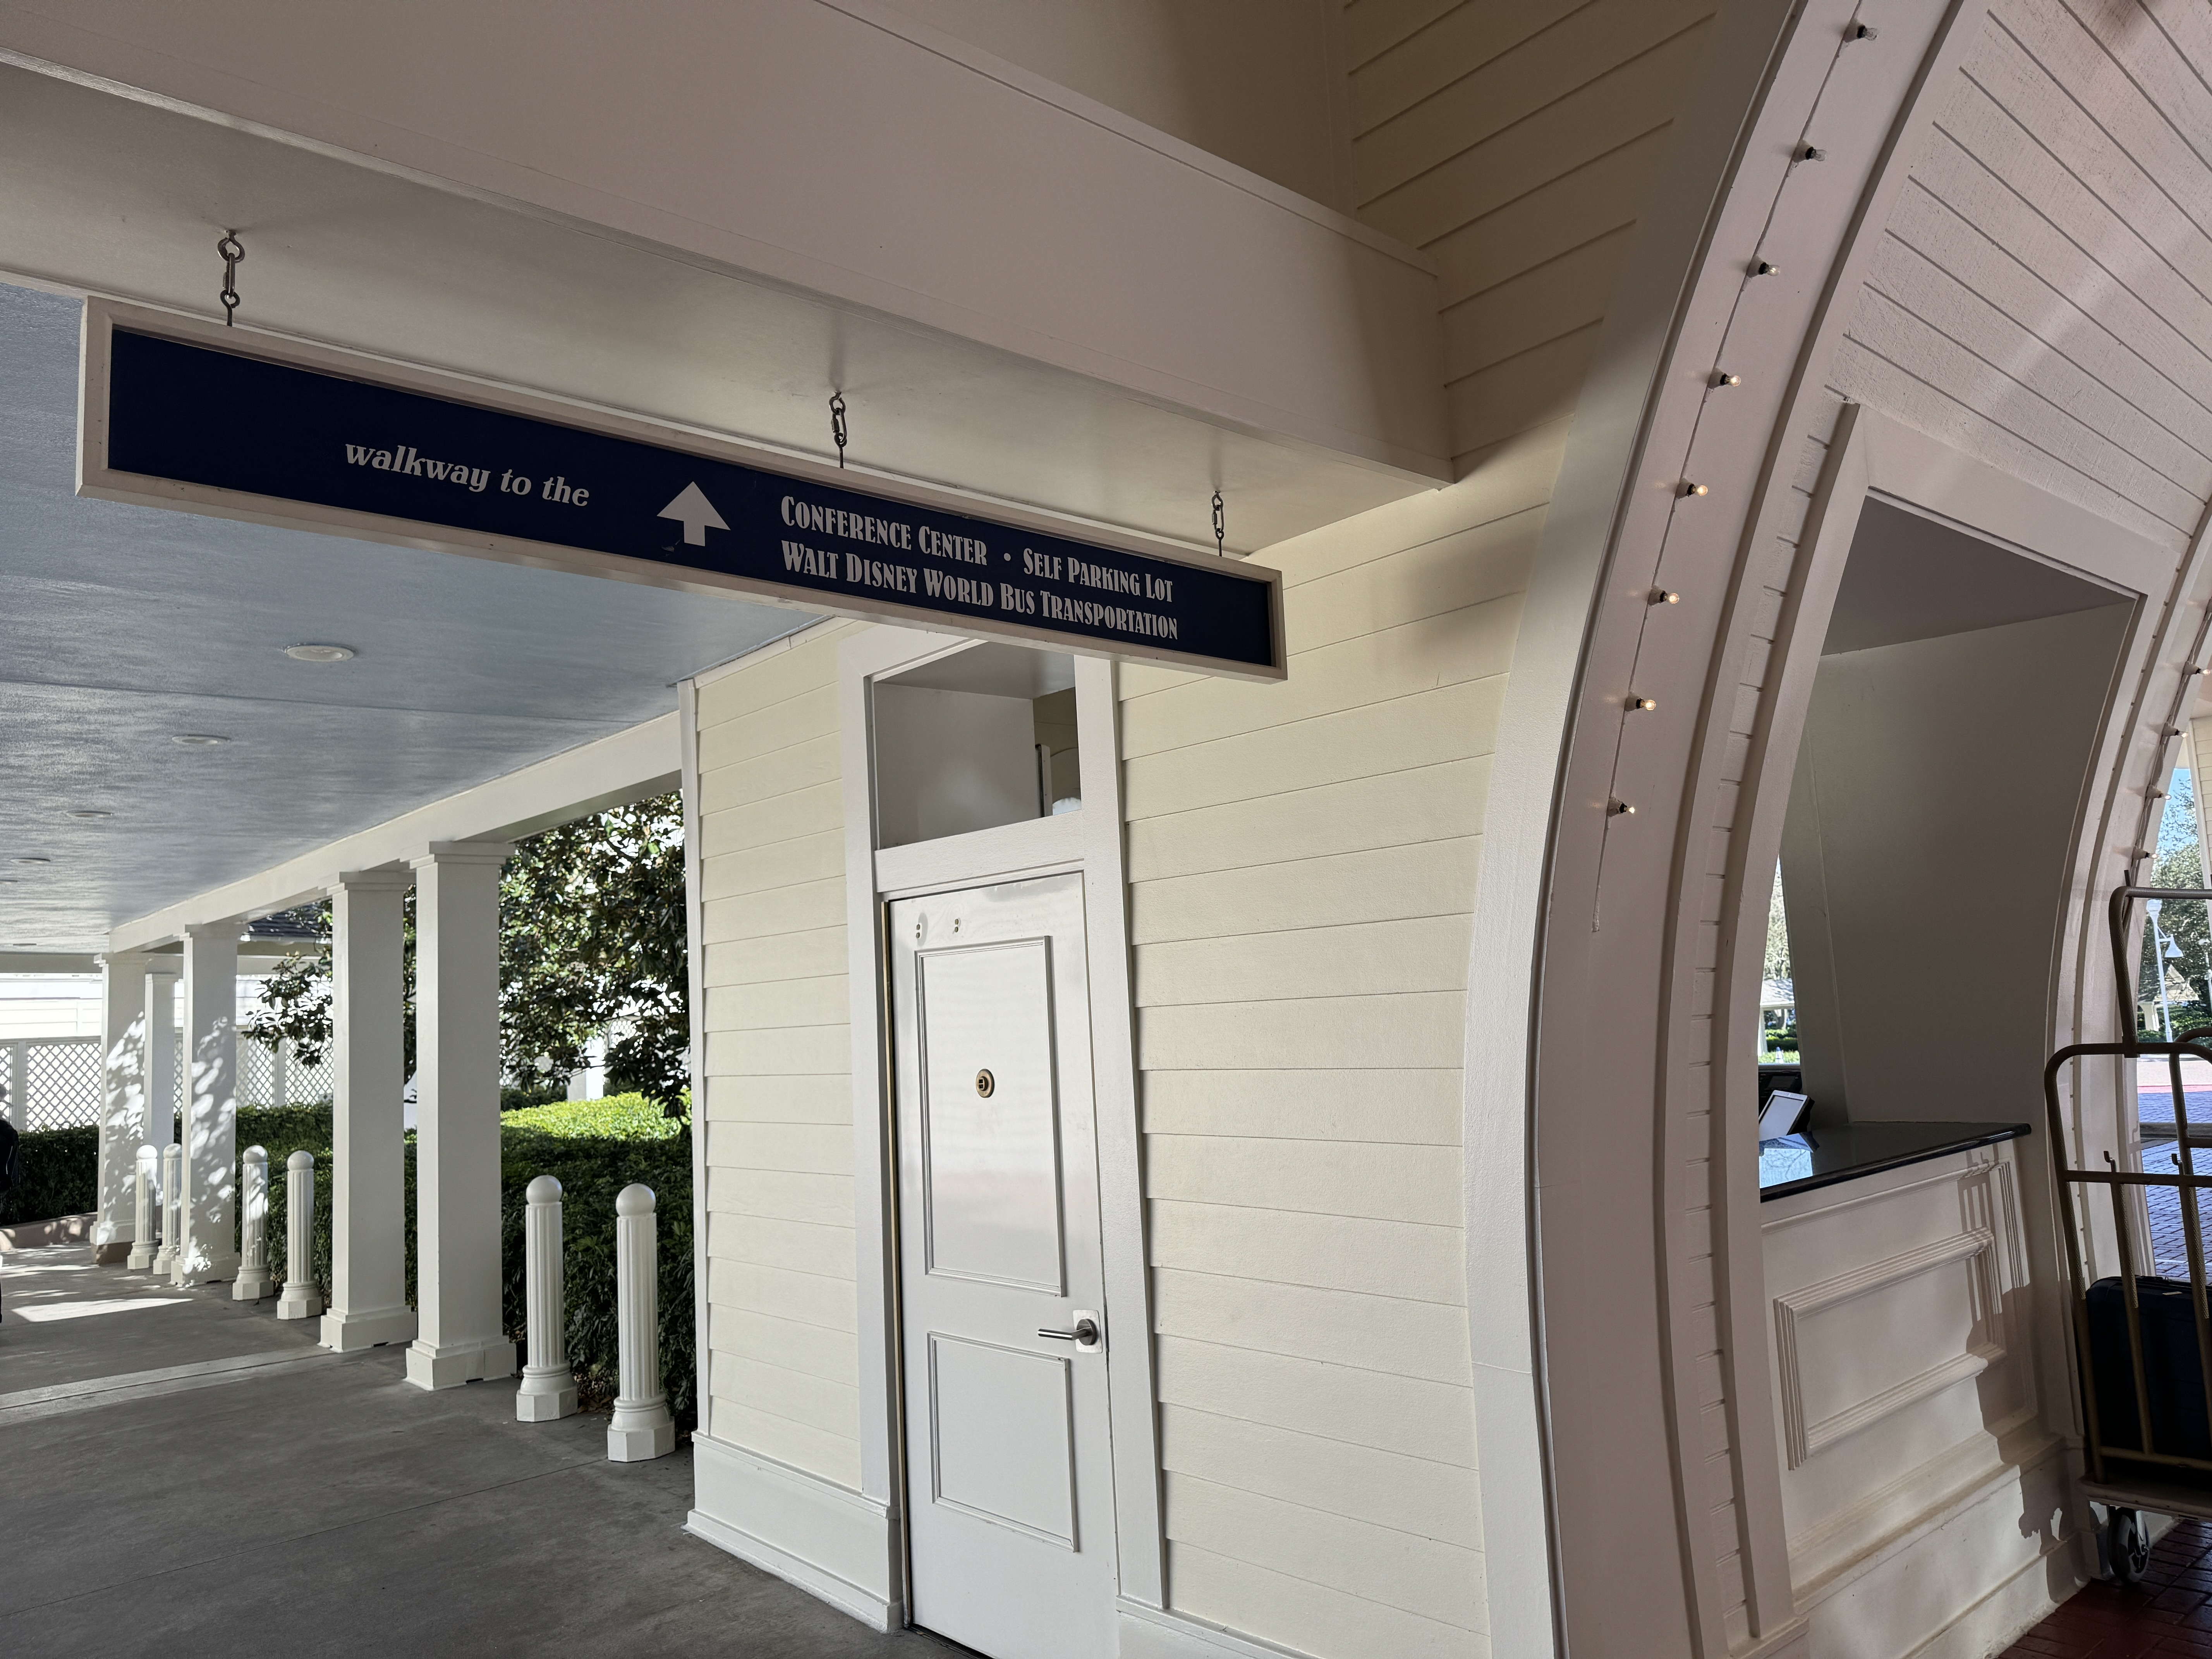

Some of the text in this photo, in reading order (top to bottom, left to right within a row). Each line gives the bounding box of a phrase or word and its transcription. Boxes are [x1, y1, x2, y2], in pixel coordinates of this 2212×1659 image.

[345, 443, 589, 507] walkway to the
[781, 496, 1173, 602] CONFERENCE CENTER SELF PARKING LOT
[781, 540, 1178, 640] WALT DISNEY WORLD BUS TRANSPORTATION
